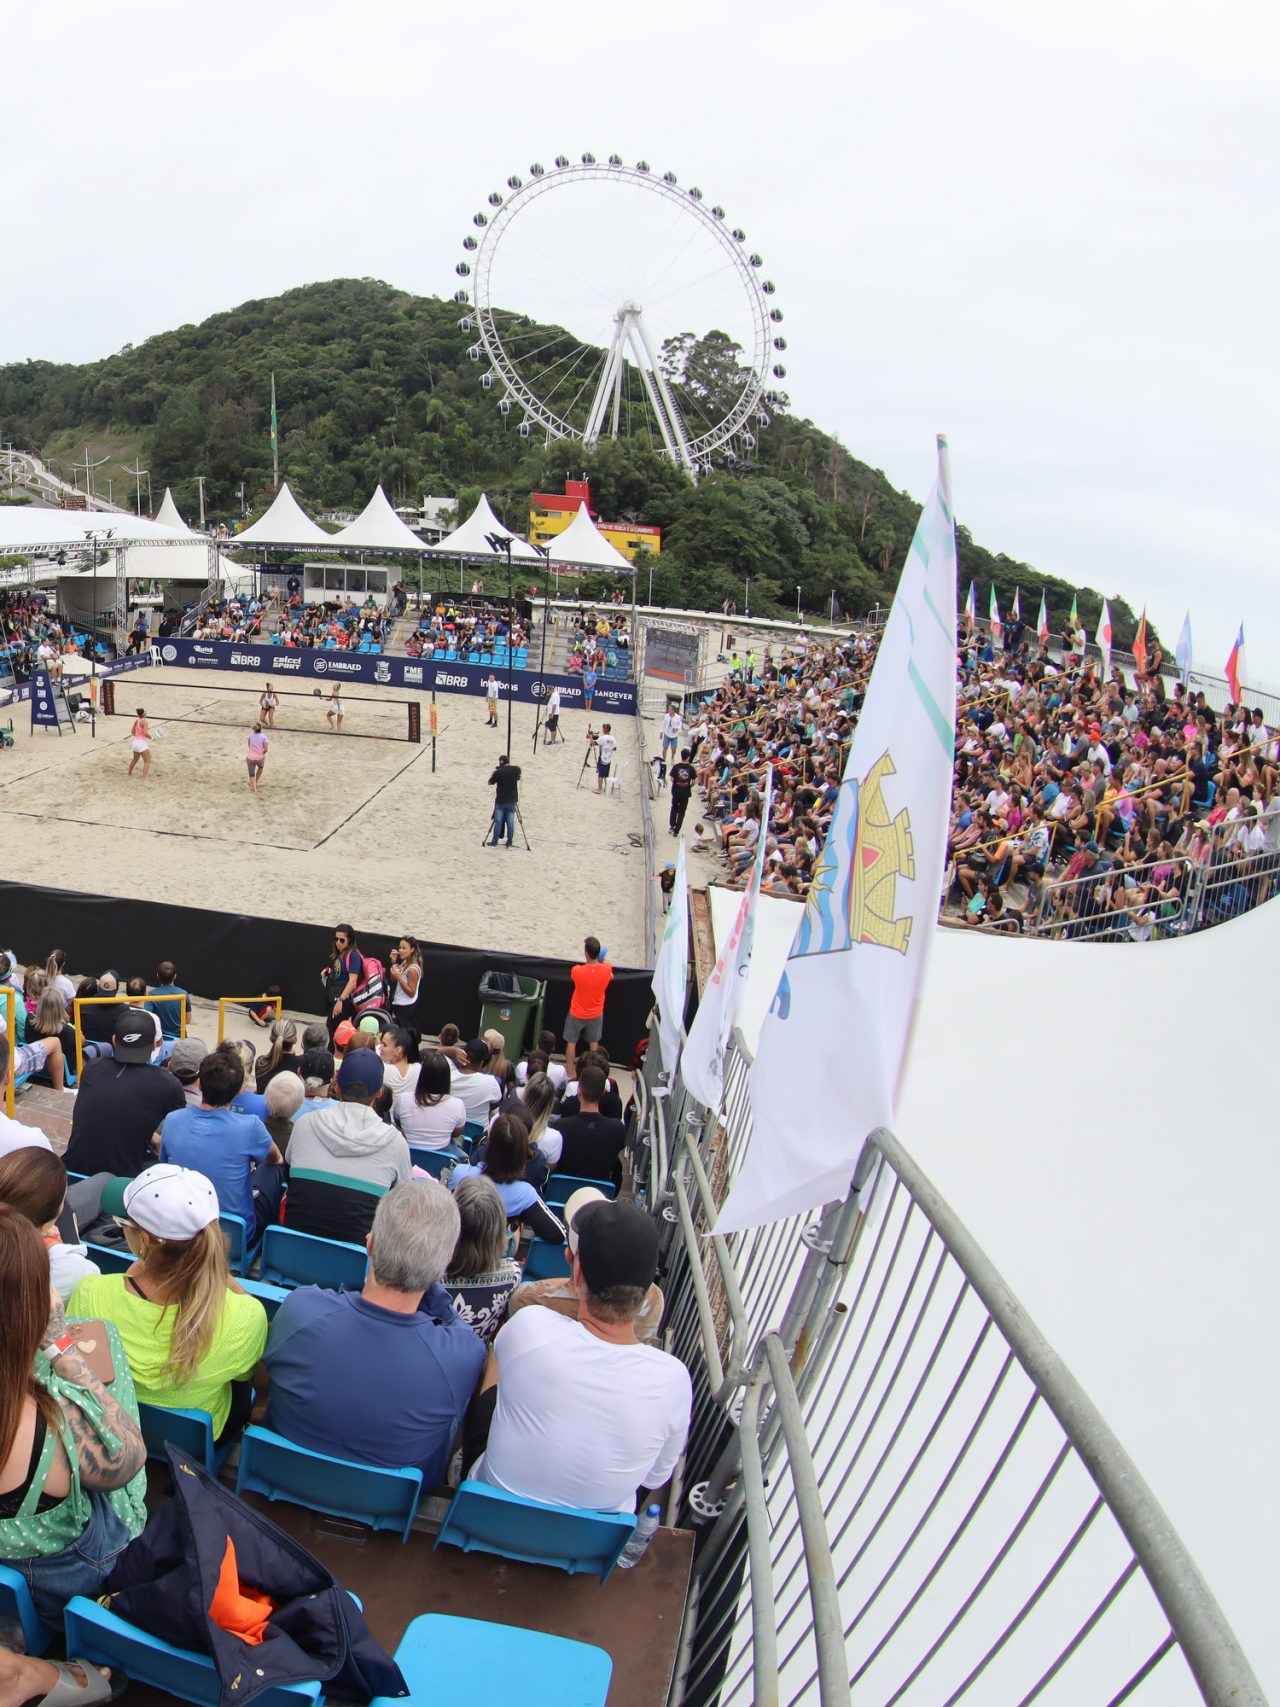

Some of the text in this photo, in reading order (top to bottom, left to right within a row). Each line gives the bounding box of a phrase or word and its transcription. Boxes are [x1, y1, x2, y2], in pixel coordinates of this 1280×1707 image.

[241, 655, 261, 667] BRB
[273, 662, 301, 670] SPORT
[328, 661, 362, 671] EMBRAED
[403, 665, 423, 675] FME
[446, 675, 468, 688] BRB
[594, 690, 633, 700] SANDEVER
